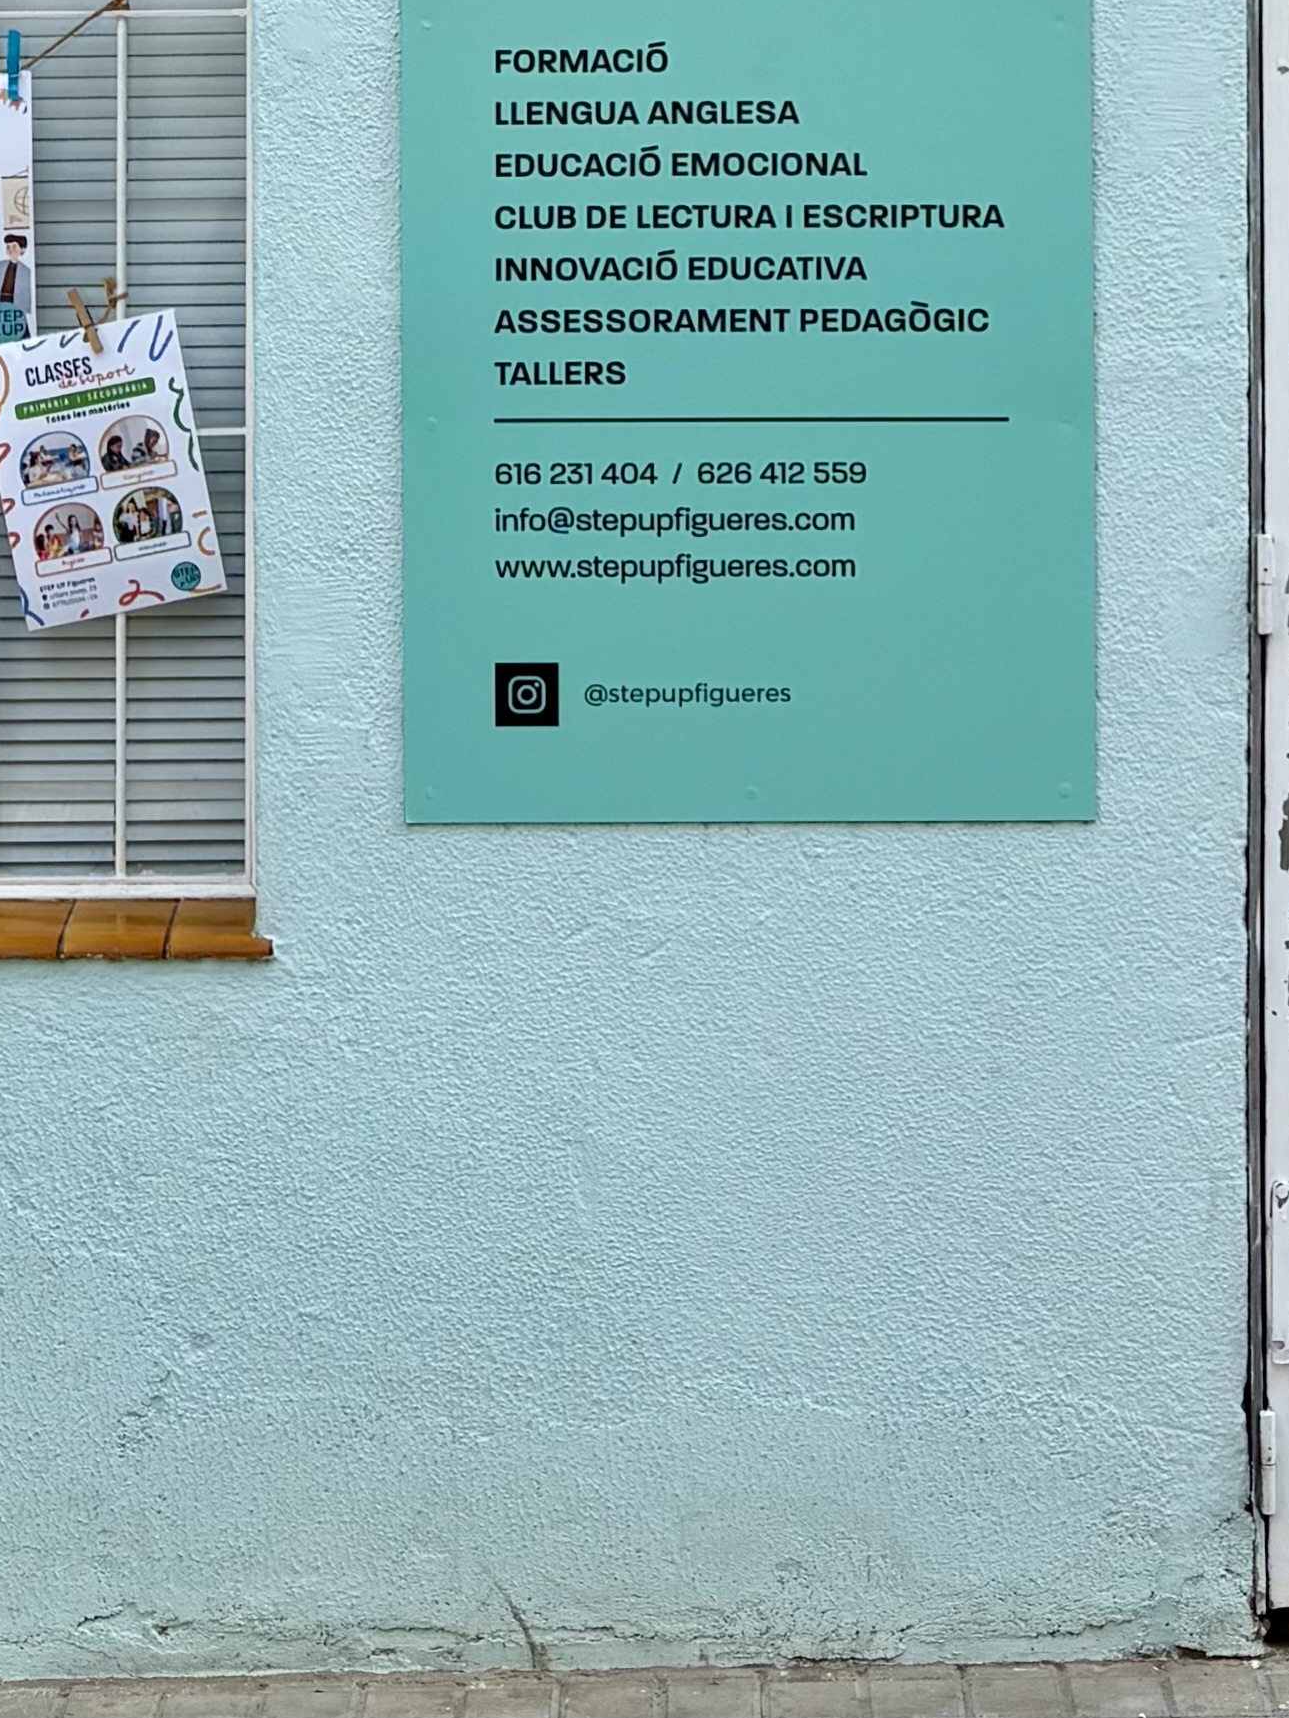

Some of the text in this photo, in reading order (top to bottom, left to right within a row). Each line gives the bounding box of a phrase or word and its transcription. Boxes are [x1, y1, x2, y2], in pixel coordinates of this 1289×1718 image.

[496, 42, 668, 74] FORMACIÓ
[496, 101, 799, 126] LLENGUA ANGLESA
[496, 145, 868, 178] EDUCACIÓ EMOCIONAL
[495, 204, 1005, 230] CLUB DE LECTURA I ESCRIPTURA
[496, 250, 868, 282] INNOVACIÓ EDUCATIVA
[2, 324, 24, 335] UP
[495, 301, 990, 334] ASSESSORAMENT PEDAGÒGIC
[25, 356, 93, 387] CLASSES
[494, 361, 626, 386] TALLERS
[73, 410, 87, 419] les
[495, 462, 867, 486] 616 231 404 / 626 412 559
[495, 507, 855, 538] info@stepupfigueres.com
[495, 554, 856, 585] www.stepupfigueres.com
[584, 682, 792, 708] @stepupfigueres
